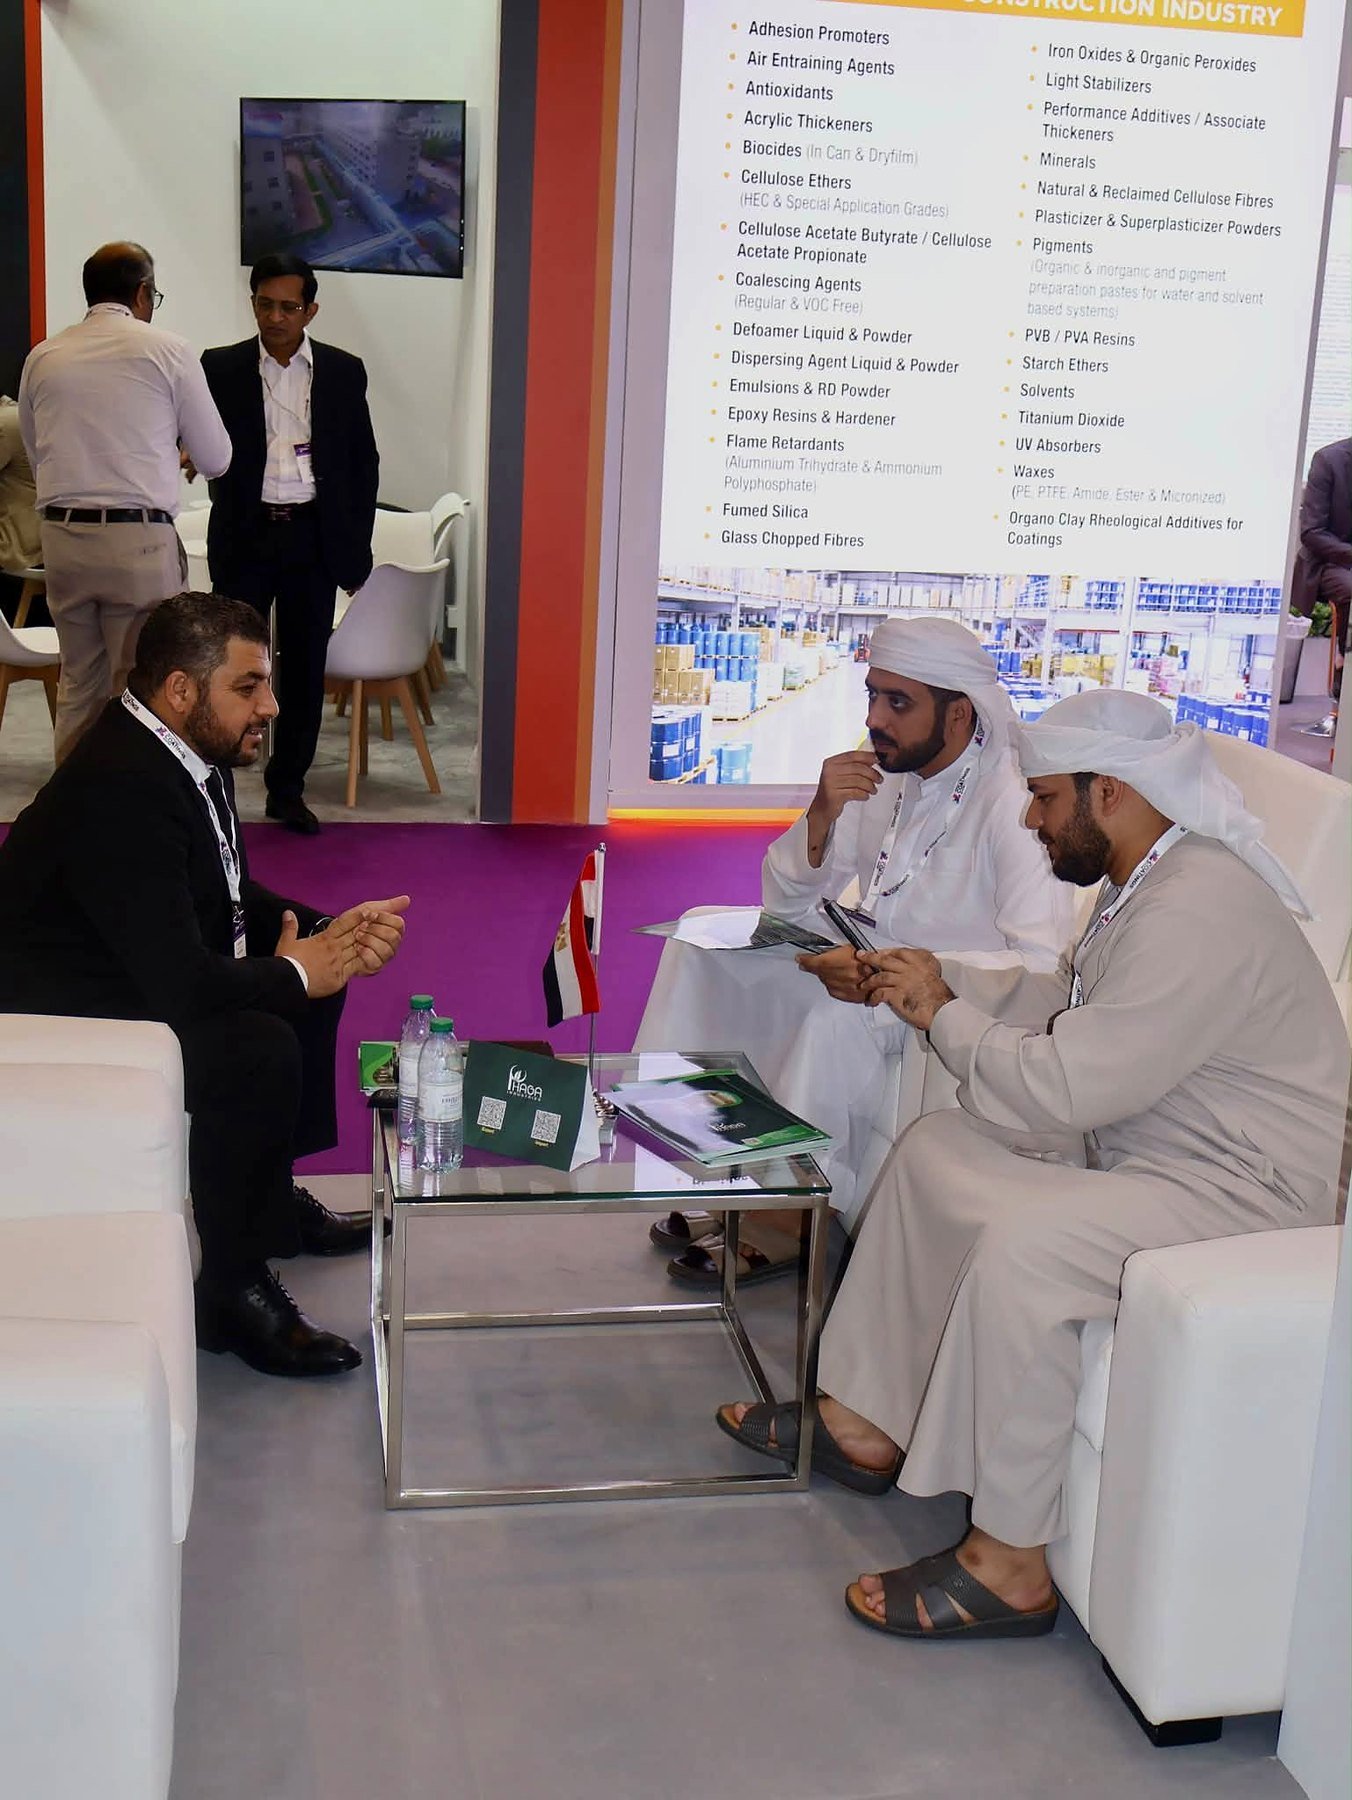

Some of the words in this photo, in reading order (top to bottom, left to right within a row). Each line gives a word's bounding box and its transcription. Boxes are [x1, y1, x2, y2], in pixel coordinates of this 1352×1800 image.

[1162, 0, 1283, 27] INDUSTRY
[749, 21, 814, 40] Adhesion
[819, 26, 889, 45] Promoters
[747, 50, 767, 65] Air
[772, 52, 842, 74] Entraining
[847, 58, 895, 77] Agents
[1049, 43, 1074, 58] Iron
[1078, 45, 1122, 63] Oxides
[1126, 49, 1135, 64] &
[1140, 50, 1190, 69] Organic
[1194, 54, 1256, 73] Peroxides
[746, 81, 833, 100] Antioxidants
[1046, 72, 1079, 91] Light
[1083, 74, 1152, 94] Stabilizers
[744, 111, 792, 129] Acrylic
[798, 113, 872, 132] Thickeners
[1044, 101, 1127, 121] Performance
[1131, 107, 1190, 125] Additives
[1204, 112, 1266, 130] Associate
[1043, 124, 1114, 142] Thickeners
[743, 139, 802, 157] Biocides
[826, 144, 851, 160] Can
[1040, 152, 1096, 170] Minerals
[741, 169, 804, 186] Cellulose
[809, 174, 851, 189] Ethers
[786, 193, 830, 211] Special
[833, 197, 900, 215] Application
[1038, 181, 1085, 197] Natural
[1089, 184, 1098, 198] &
[1103, 185, 1170, 202] Reclaimed
[1174, 189, 1231, 206] Cellulose
[1235, 193, 1273, 208] Fibres
[1035, 208, 1102, 226] Plasticizer
[1107, 214, 1116, 227] &
[1120, 213, 1223, 233] Superplasticizer
[1227, 221, 1281, 237] Powders
[738, 220, 801, 238] Cellulose
[805, 225, 857, 241] Acetate
[861, 228, 918, 245] Butyrate
[932, 232, 991, 249] Cellulose
[737, 243, 789, 260] Acetate
[794, 246, 867, 264] Propionate
[1033, 237, 1093, 255] Pigments
[736, 271, 810, 292] Coalescing
[815, 276, 861, 293] Agents
[803, 296, 829, 312] VOC
[733, 322, 799, 338] Defoamer
[803, 325, 844, 342] Liquid
[849, 327, 858, 341] &
[863, 328, 912, 343] Powder
[1025, 328, 1050, 342] PVB
[1064, 330, 1088, 344] PVA
[1093, 331, 1135, 346] Resins
[731, 350, 803, 370] Dispersing
[808, 354, 847, 371] Agent
[851, 355, 892, 373] Liquid
[896, 357, 905, 372] &
[910, 358, 959, 373] Powder
[1023, 356, 1064, 371] Starch
[1068, 358, 1108, 373] Ethers
[730, 379, 799, 394] Emulsions
[804, 381, 813, 395] &
[818, 382, 836, 396] RD
[841, 383, 890, 398] Powder
[1020, 382, 1075, 399] Solvents
[728, 407, 768, 424] Epoxy
[773, 408, 817, 423] Resins
[821, 410, 831, 424] &
[836, 411, 895, 426] Hardener
[1019, 410, 1073, 425] Titanium
[1078, 412, 1125, 427] Dioxide
[727, 434, 767, 449] Flame
[772, 436, 844, 451] Retardants
[1016, 437, 1033, 451] UV
[1036, 438, 1101, 454] Absorbers
[799, 457, 858, 475] Trihydrate
[874, 460, 942, 476] Ammonium
[1014, 464, 1055, 479] Waxes
[723, 502, 768, 517] Fumed
[772, 504, 808, 518] Silica
[1009, 511, 1055, 528] Organo
[1058, 512, 1085, 529] Clay
[1089, 513, 1162, 531] Rheological
[1166, 515, 1222, 530] Additives
[1227, 517, 1243, 530] for
[721, 530, 757, 544] Glass
[762, 531, 820, 548] Chopped
[824, 533, 864, 547] Fibres
[1007, 531, 1062, 548] Coatings
